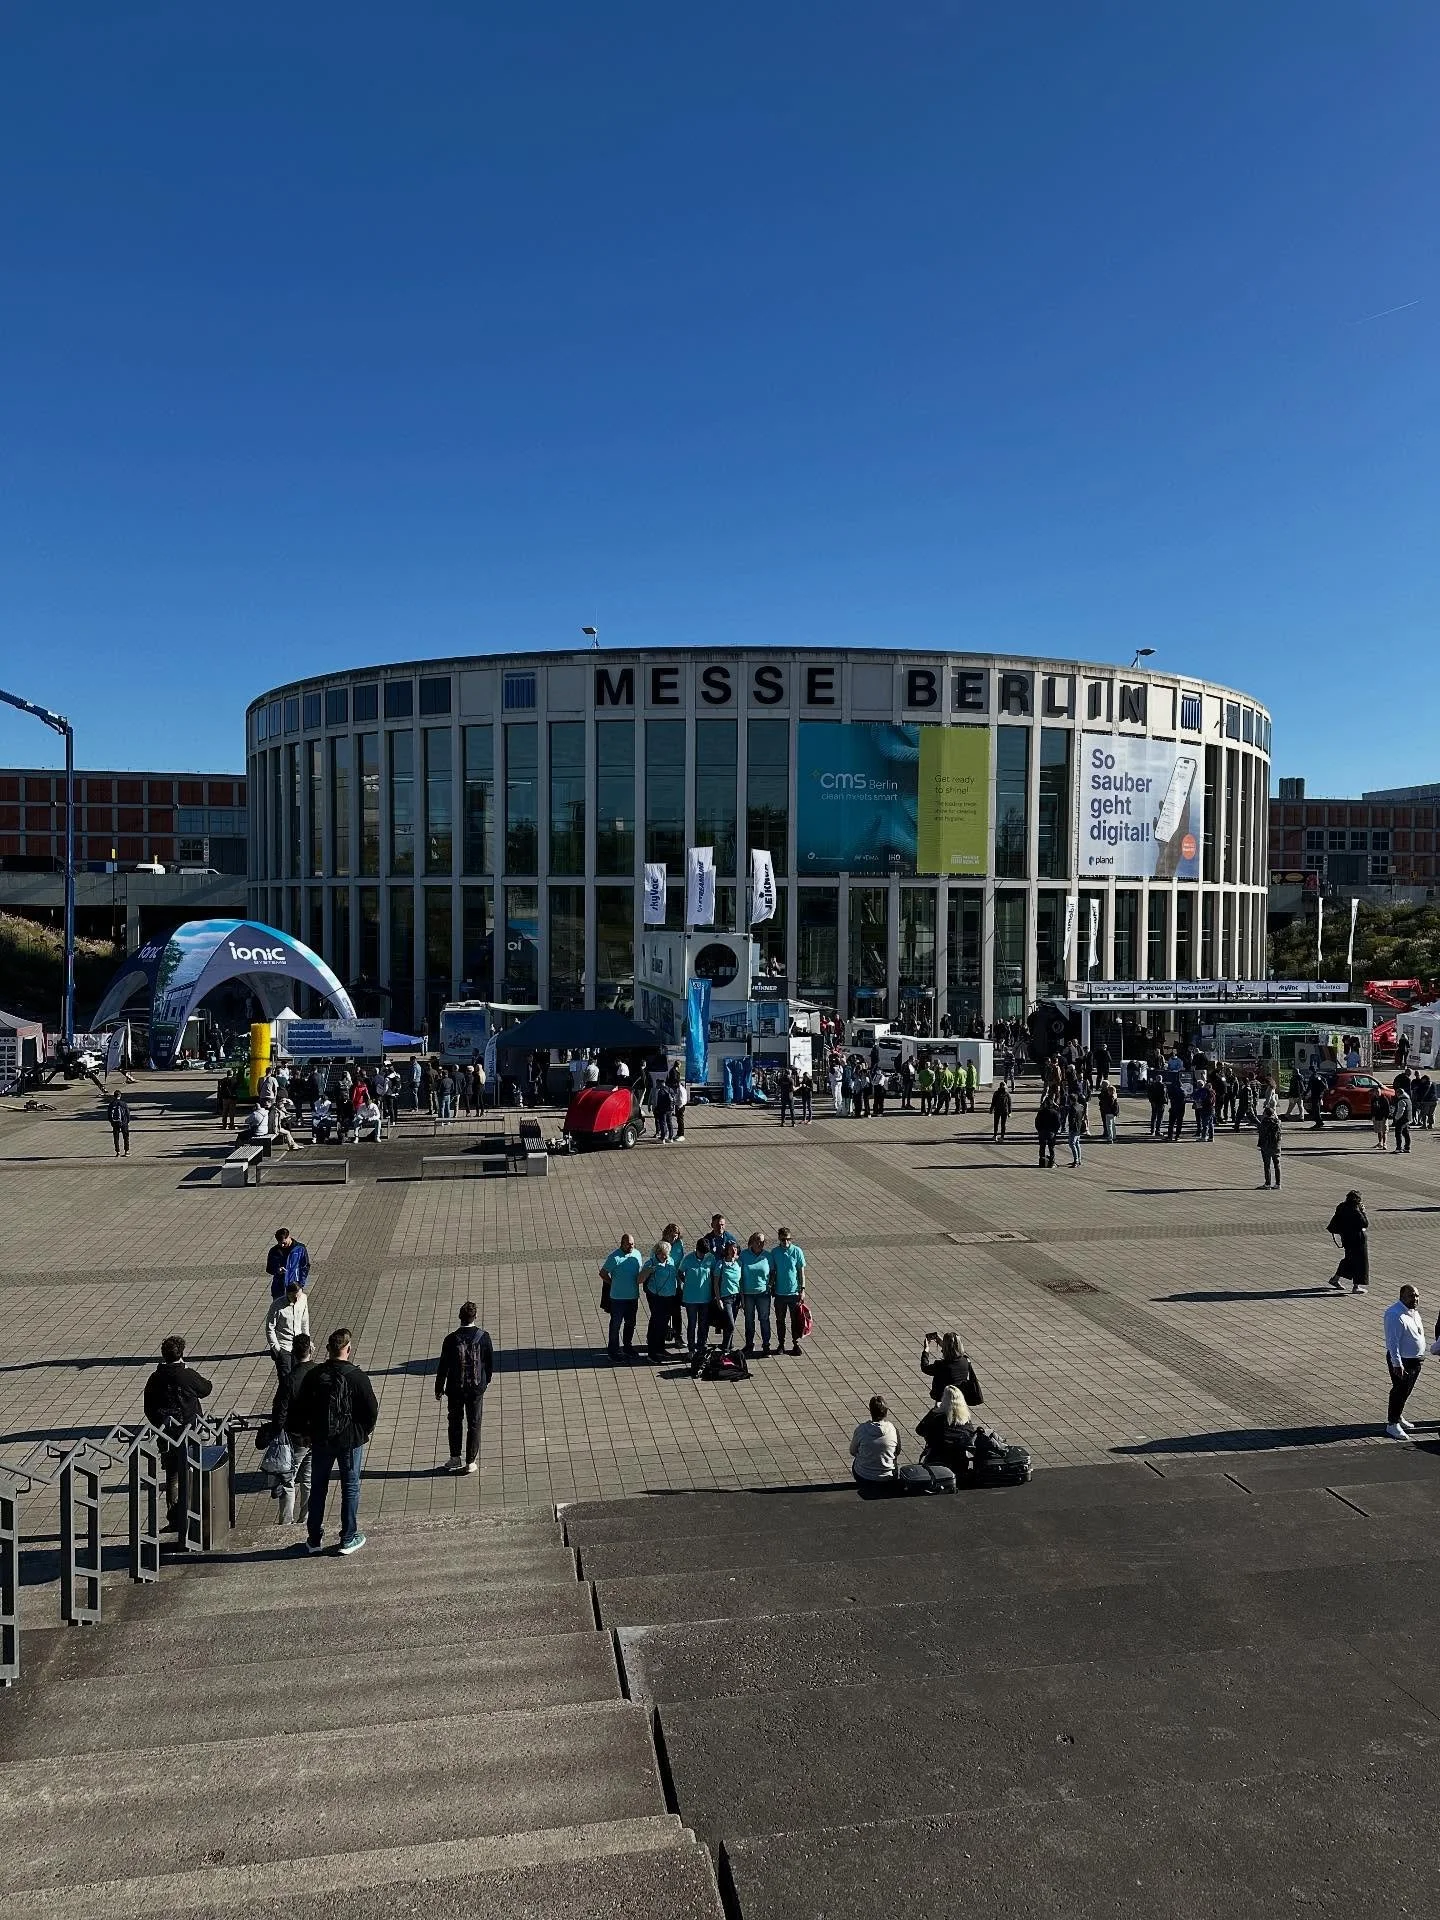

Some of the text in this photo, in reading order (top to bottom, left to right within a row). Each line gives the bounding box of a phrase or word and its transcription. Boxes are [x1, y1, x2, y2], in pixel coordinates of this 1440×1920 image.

[596, 665, 1146, 724] MESSE BERLIN
[1091, 748, 1116, 769] So
[820, 772, 898, 790] cms Berlin
[934, 775, 975, 785] Get ready
[1091, 772, 1153, 793] sauber
[821, 793, 844, 801] clean
[873, 793, 898, 801] smart
[935, 786, 969, 795] to shine!
[1090, 794, 1132, 818] geht
[1090, 820, 1150, 846] digital!
[1095, 856, 1114, 865] pland
[650, 877, 660, 911] skyVac
[228, 941, 286, 961] ionic
